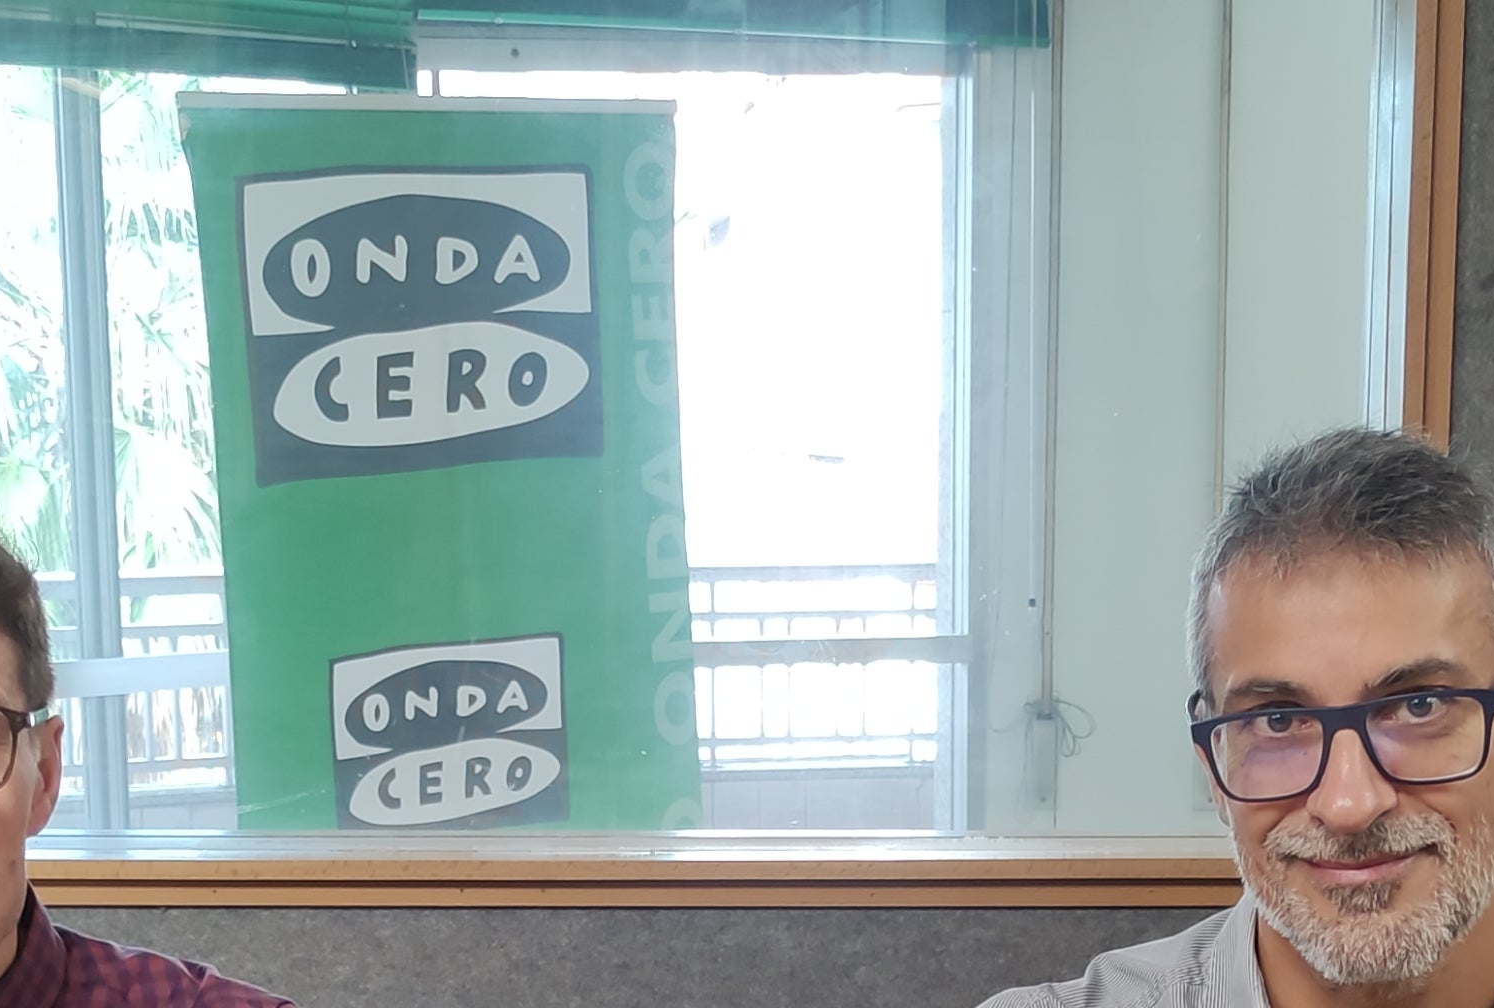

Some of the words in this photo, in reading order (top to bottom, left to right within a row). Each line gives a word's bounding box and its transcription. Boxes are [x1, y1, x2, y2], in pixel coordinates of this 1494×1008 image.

[291, 235, 540, 297] ONDA
[623, 141, 678, 405] CERO
[314, 349, 547, 422] CERO
[640, 441, 697, 746] ONDA
[363, 680, 529, 732] ONDA
[378, 756, 532, 810] CERO
